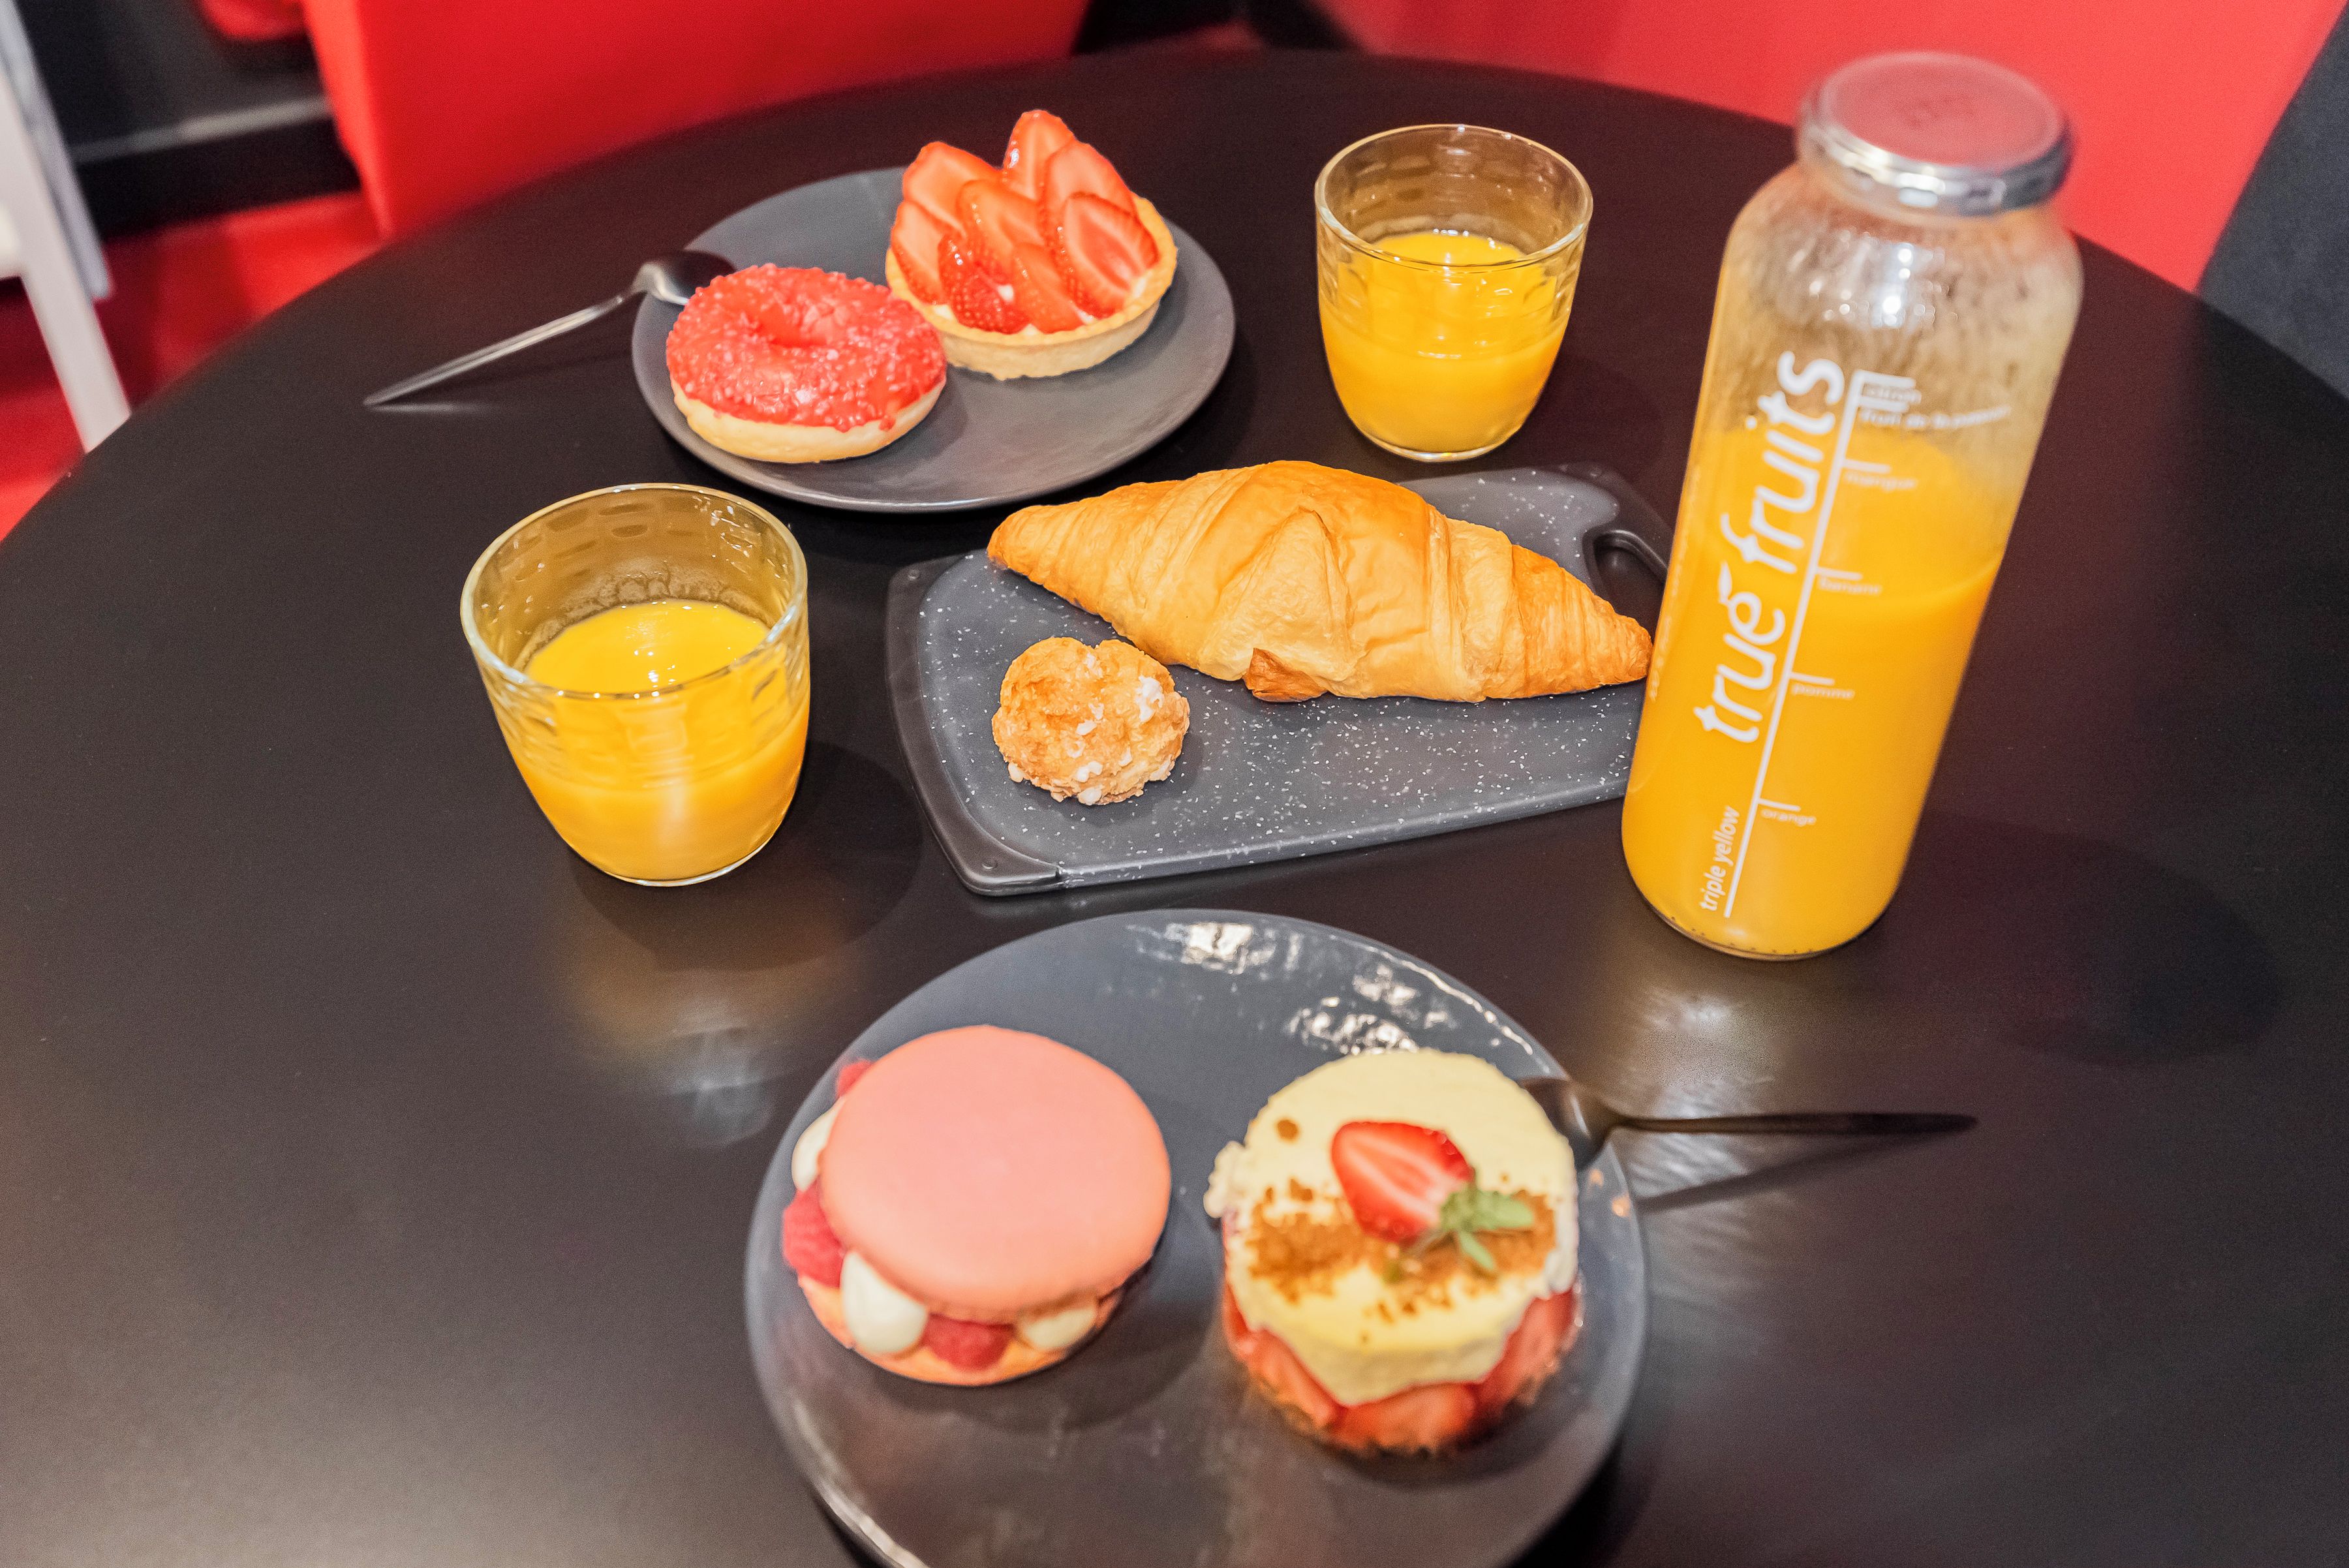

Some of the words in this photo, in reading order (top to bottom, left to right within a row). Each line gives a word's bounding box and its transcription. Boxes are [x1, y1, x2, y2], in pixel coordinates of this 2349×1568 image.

[1719, 350, 1845, 574] fruits
[1693, 560, 1787, 743] true
[1791, 683, 1854, 699] pomme
[1712, 805, 1740, 867] yellow
[1761, 809, 1817, 827] orange
[1699, 865, 1727, 912] triple
